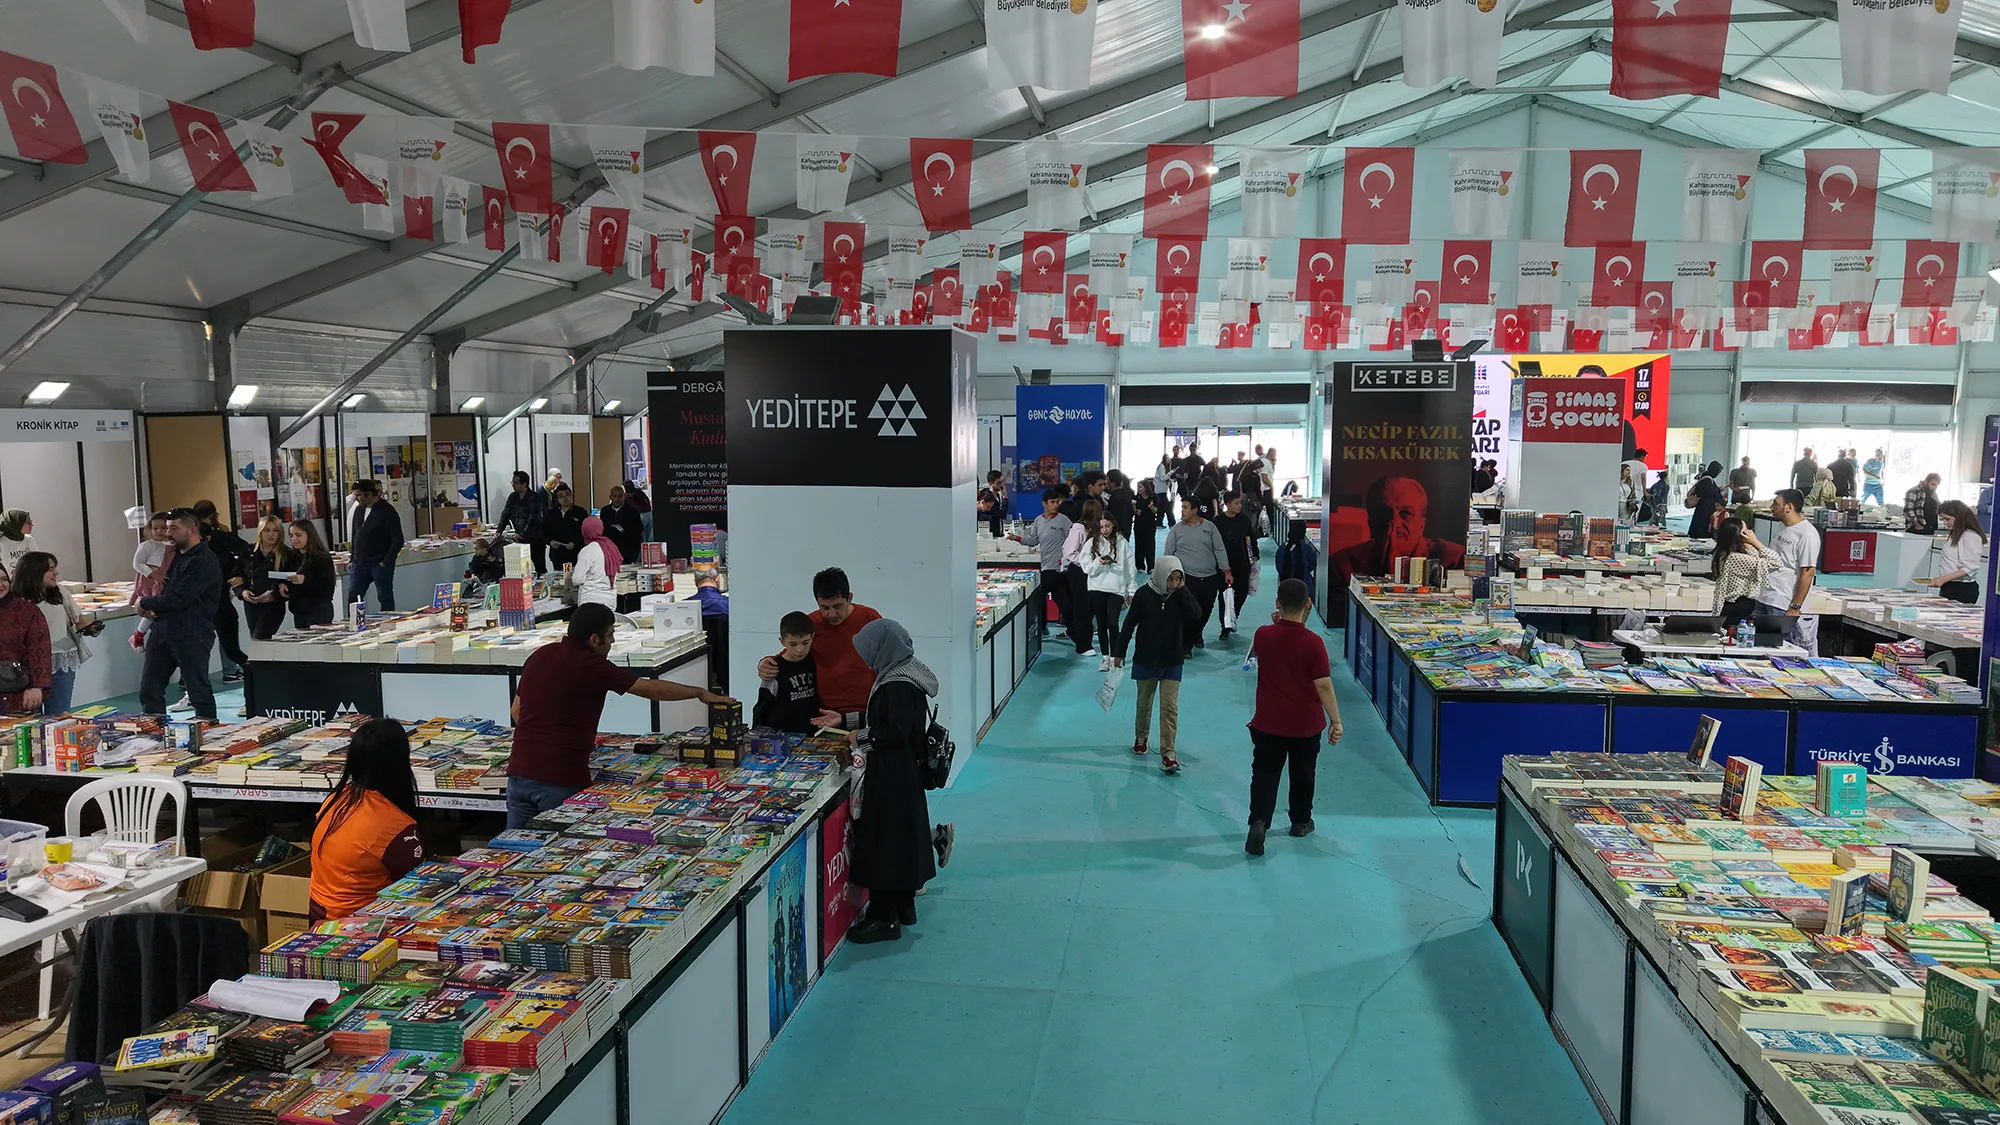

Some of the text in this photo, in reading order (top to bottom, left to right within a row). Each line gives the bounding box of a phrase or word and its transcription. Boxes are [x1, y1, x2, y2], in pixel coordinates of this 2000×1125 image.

[1245, 178, 1287, 187] Kahramanmaraş
[1454, 176, 1499, 187] Kahramanmaraş
[1360, 369, 1449, 385] KETEBE
[1638, 368, 1649, 381] 17
[682, 380, 725, 393] DERGÂ
[745, 393, 858, 428] YEDİTEPE
[1634, 401, 1649, 410] 17.00
[16, 419, 79, 431] KRONİK KİTAP
[680, 410, 726, 426] Musta
[1342, 421, 1463, 440] NECİP FAZIL
[1343, 442, 1460, 460] KISAKÜREK
[789, 672, 814, 688] NYC
[265, 705, 327, 728] YEDİTEPE
[1808, 749, 1872, 764] TÜRKİYE
[1896, 755, 1961, 768] BANKASI
[417, 796, 439, 805] RAY
[1926, 981, 1974, 1014] SHERLOCK
[1926, 1013, 1965, 1058] HOLMES
